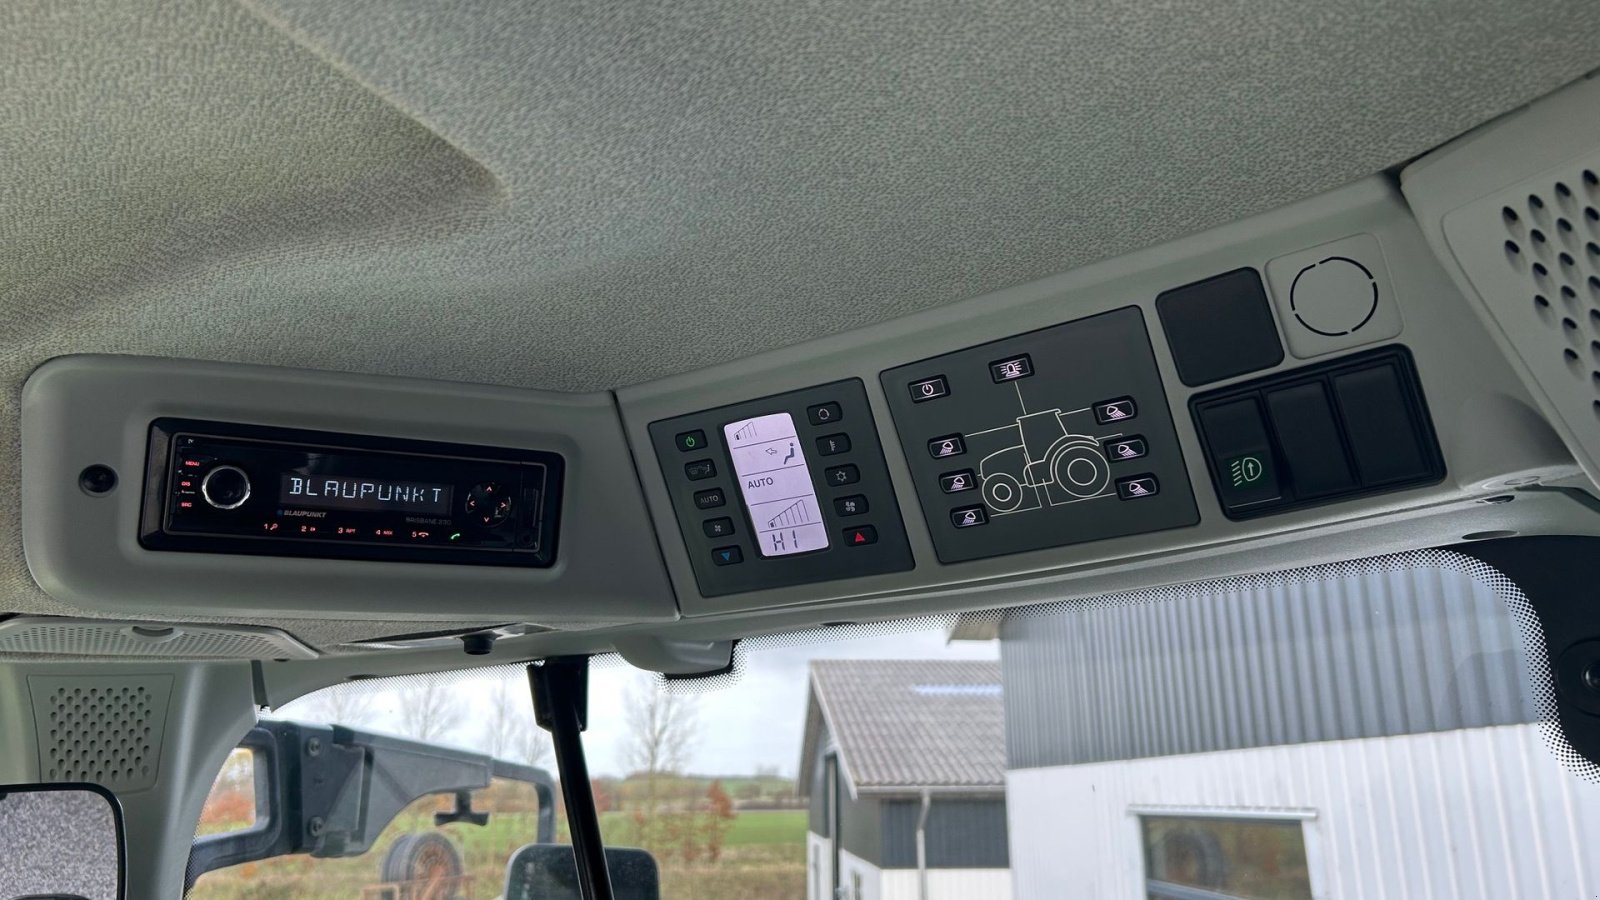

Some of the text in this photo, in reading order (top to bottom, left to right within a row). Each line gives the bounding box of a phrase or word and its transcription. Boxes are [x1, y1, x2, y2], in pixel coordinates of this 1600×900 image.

[748, 477, 774, 489] AUTO
[289, 477, 442, 503] BLAUPUNKT
[700, 495, 719, 504] AUTO
[284, 510, 327, 518] BLAUPUNKT
